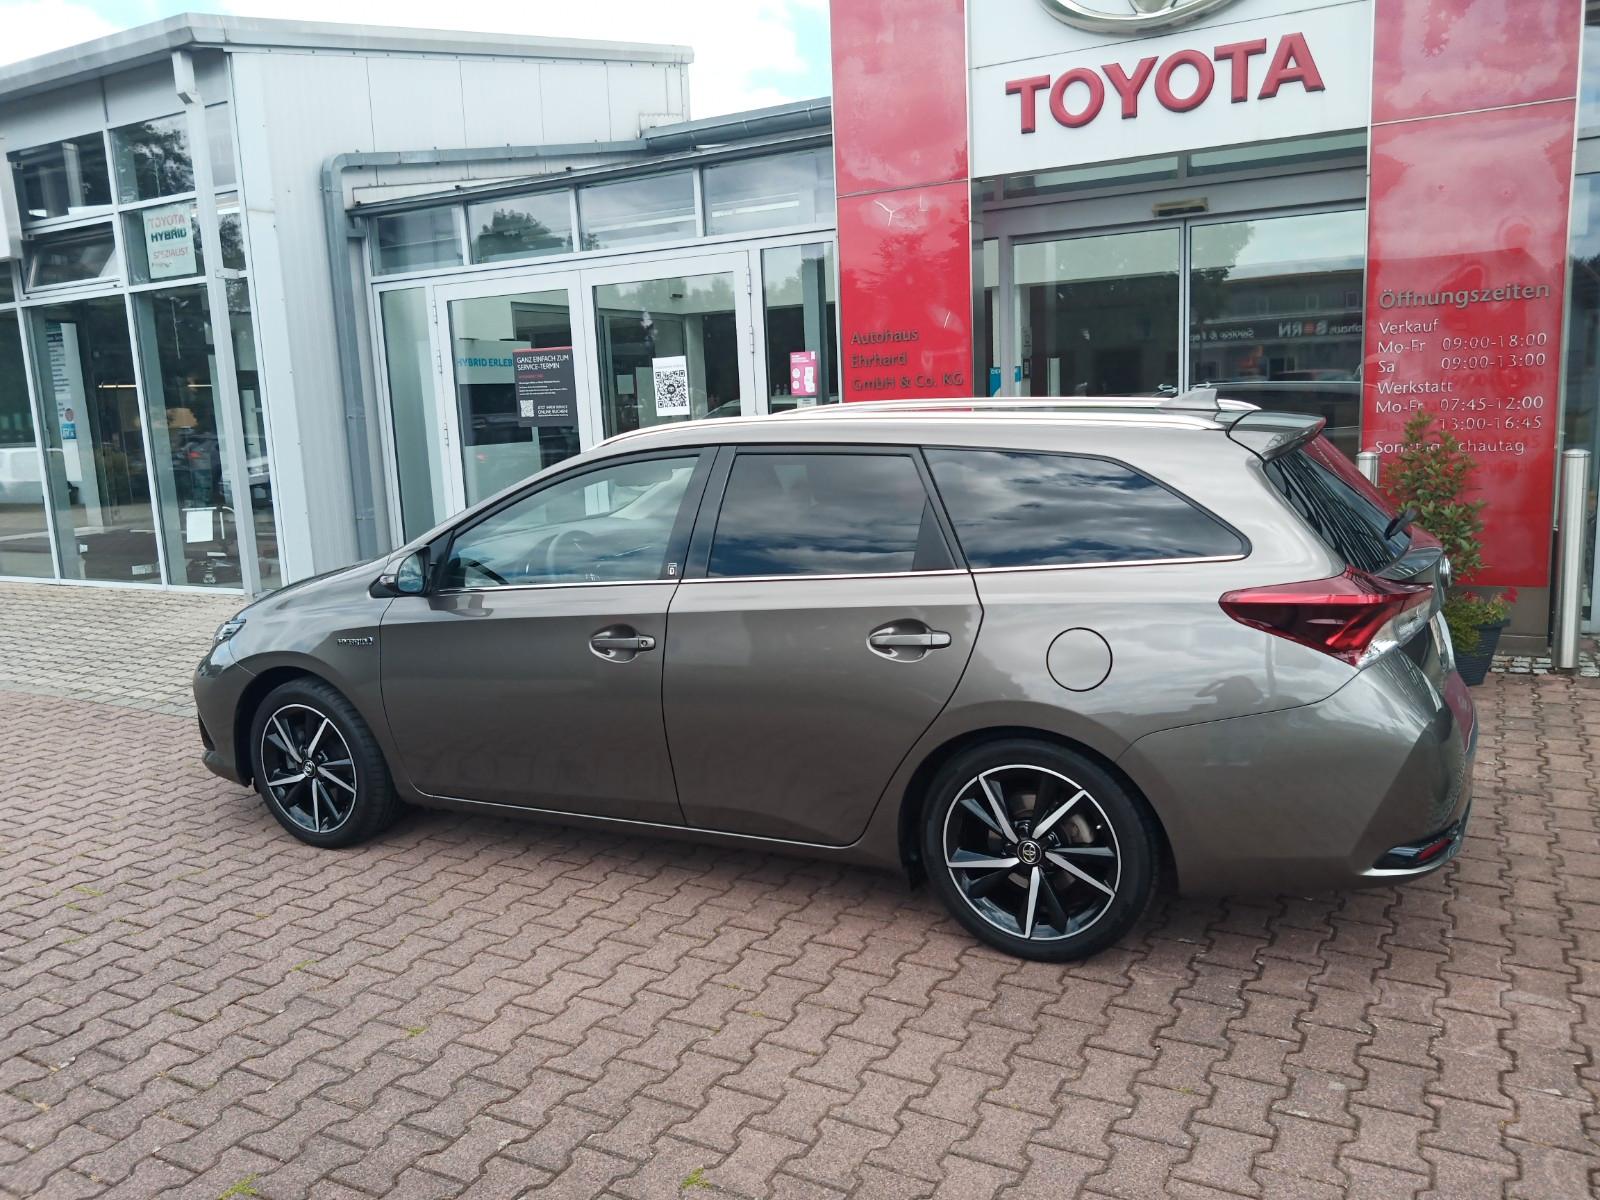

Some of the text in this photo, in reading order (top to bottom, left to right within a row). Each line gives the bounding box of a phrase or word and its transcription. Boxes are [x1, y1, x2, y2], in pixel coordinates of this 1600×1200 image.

[1005, 31, 1325, 134] TOYOTA
[148, 214, 186, 229] TOYOTA
[150, 227, 187, 243] HYBRID
[1379, 284, 1550, 309] Öffnungszeiten
[1378, 318, 1439, 336] Verkauf
[850, 329, 919, 345] Autohaus
[1377, 332, 1548, 354] Mo-Fr 09:00-18:00
[457, 358, 487, 367] HYBRID
[517, 356, 532, 364] GANZ
[533, 354, 556, 363] EINFACH
[851, 352, 907, 368] Ehrhard
[1377, 352, 1546, 373] Sa 09:00-13:00
[853, 372, 964, 391] GmbH & Co. KG
[1377, 381, 1453, 395] Werkstatt
[1375, 395, 1544, 414] Mo-Fr 07:45-12:00
[1439, 415, 1543, 432] 13:00-16:45
[1454, 439, 1525, 456] chautag
